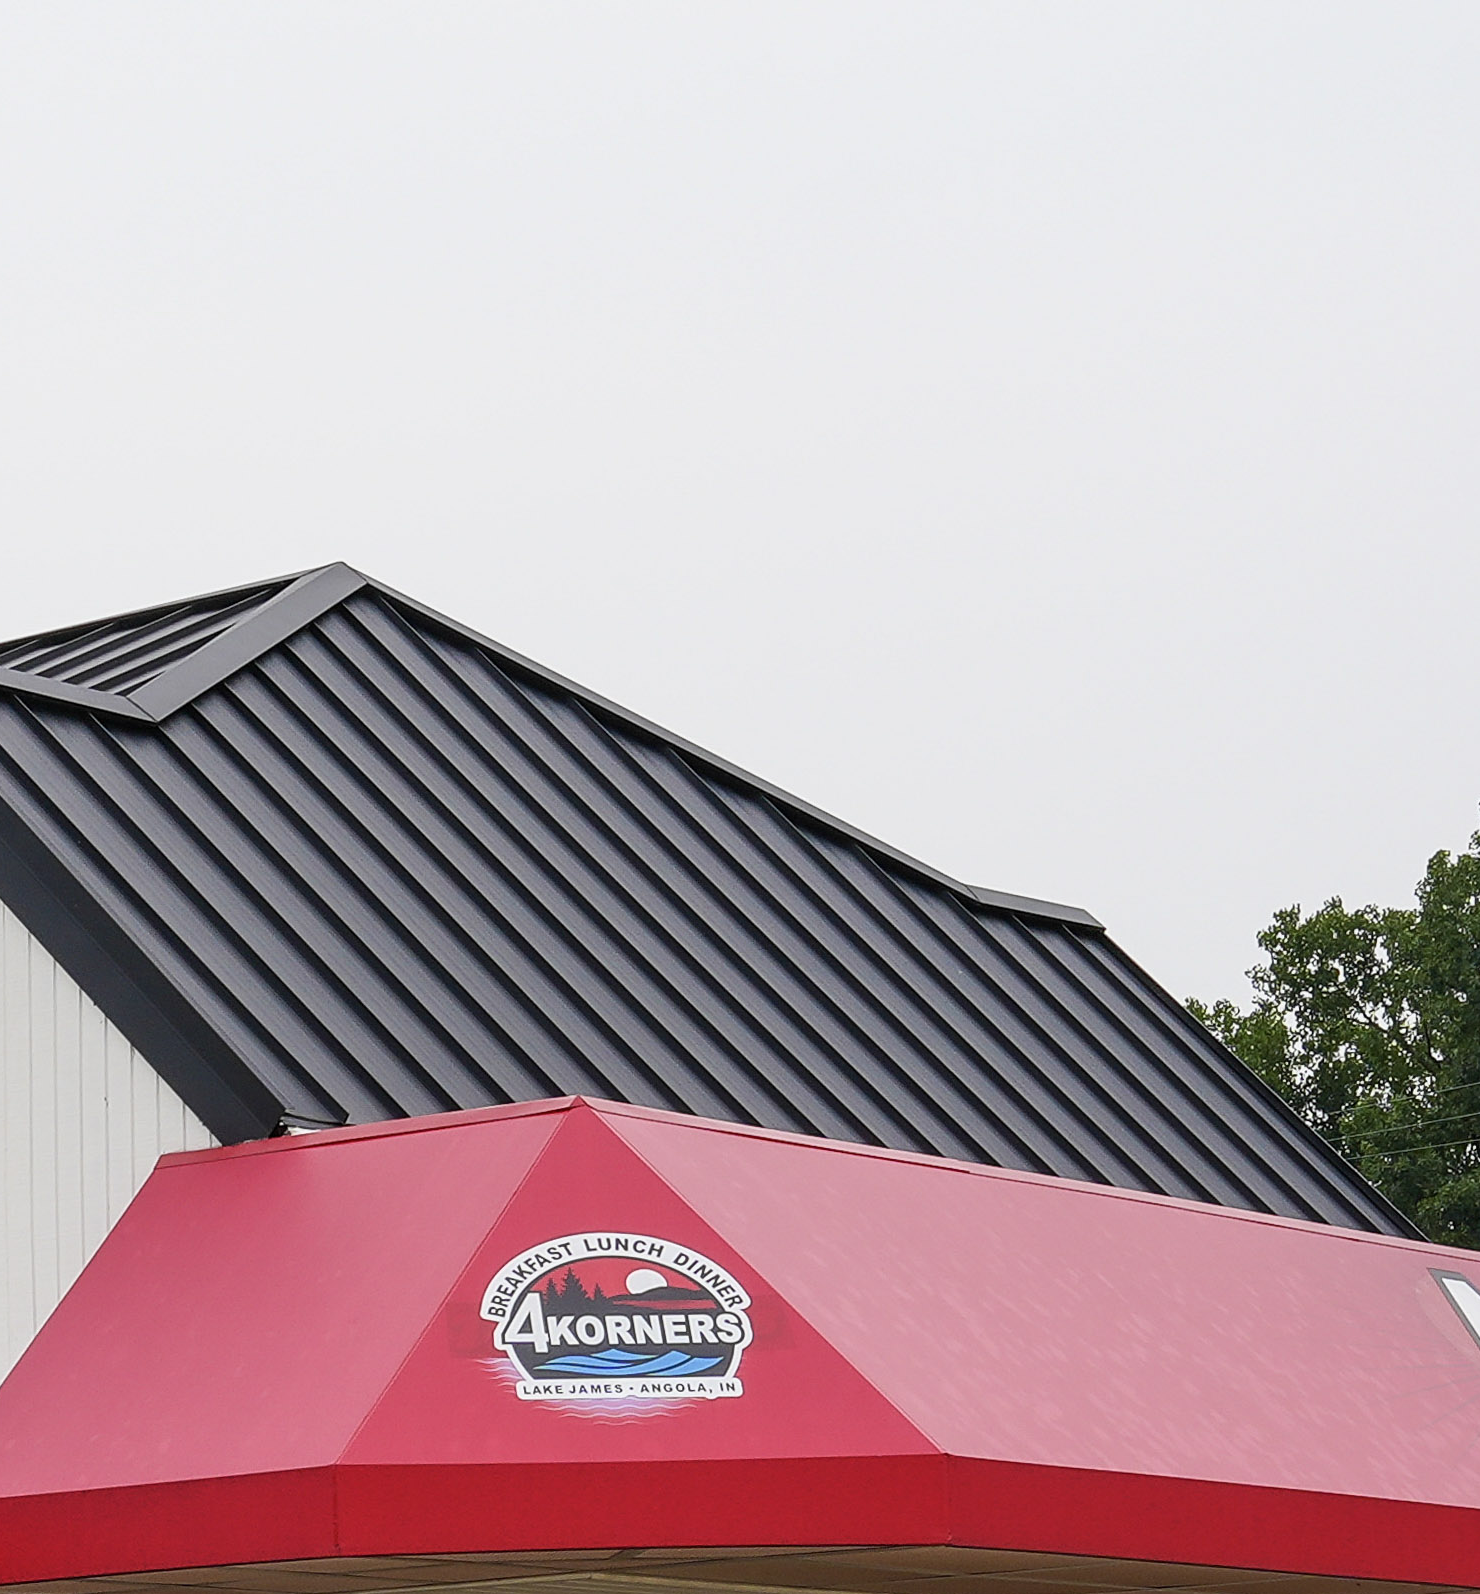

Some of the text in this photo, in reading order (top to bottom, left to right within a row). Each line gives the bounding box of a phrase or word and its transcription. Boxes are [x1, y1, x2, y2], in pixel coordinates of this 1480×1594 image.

[488, 1238, 743, 1318] BREAKFAST LUNCH DINNER
[504, 1292, 743, 1353] 4KORNERS
[523, 1382, 736, 1395] LAKE JAMES ANGOLA, IN
